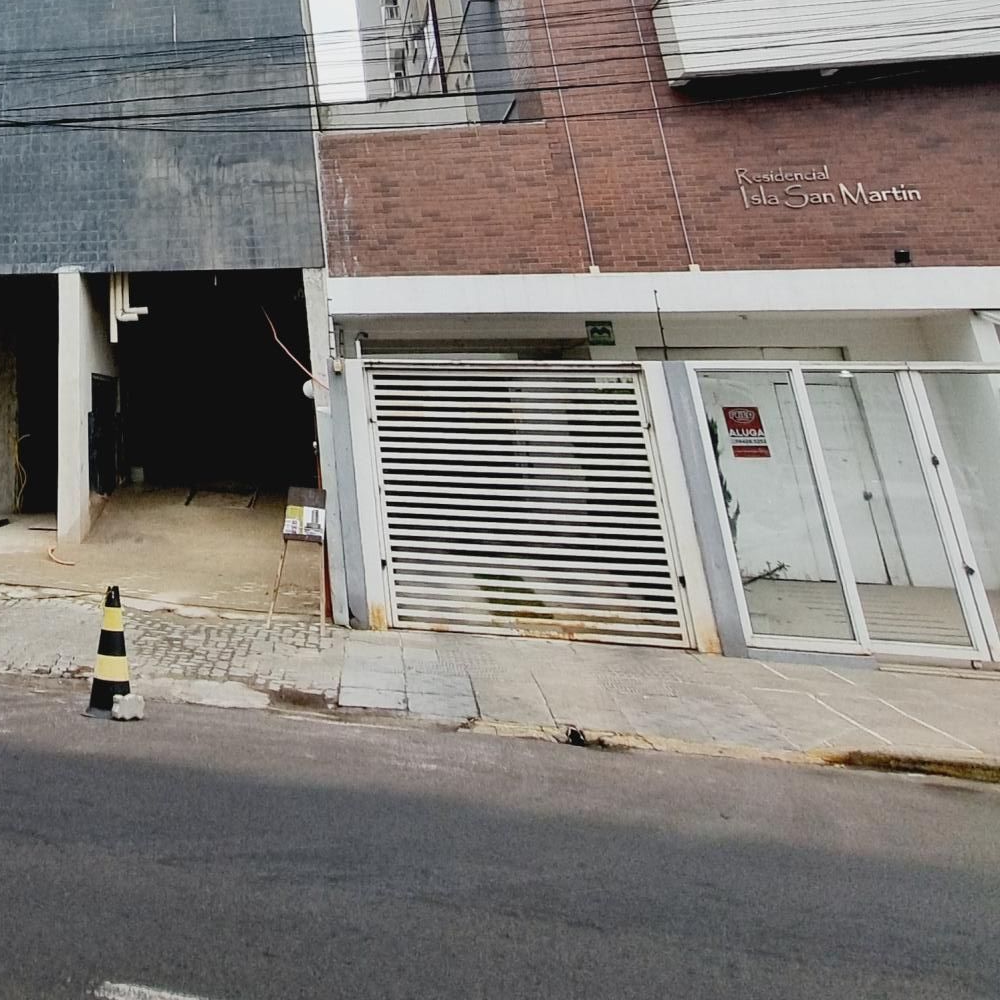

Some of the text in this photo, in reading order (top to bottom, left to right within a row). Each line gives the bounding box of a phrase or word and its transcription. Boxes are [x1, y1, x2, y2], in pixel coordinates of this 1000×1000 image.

[735, 165, 830, 185] Residencial
[740, 182, 922, 209] Isla San Martin
[729, 428, 765, 437] ALUGA
